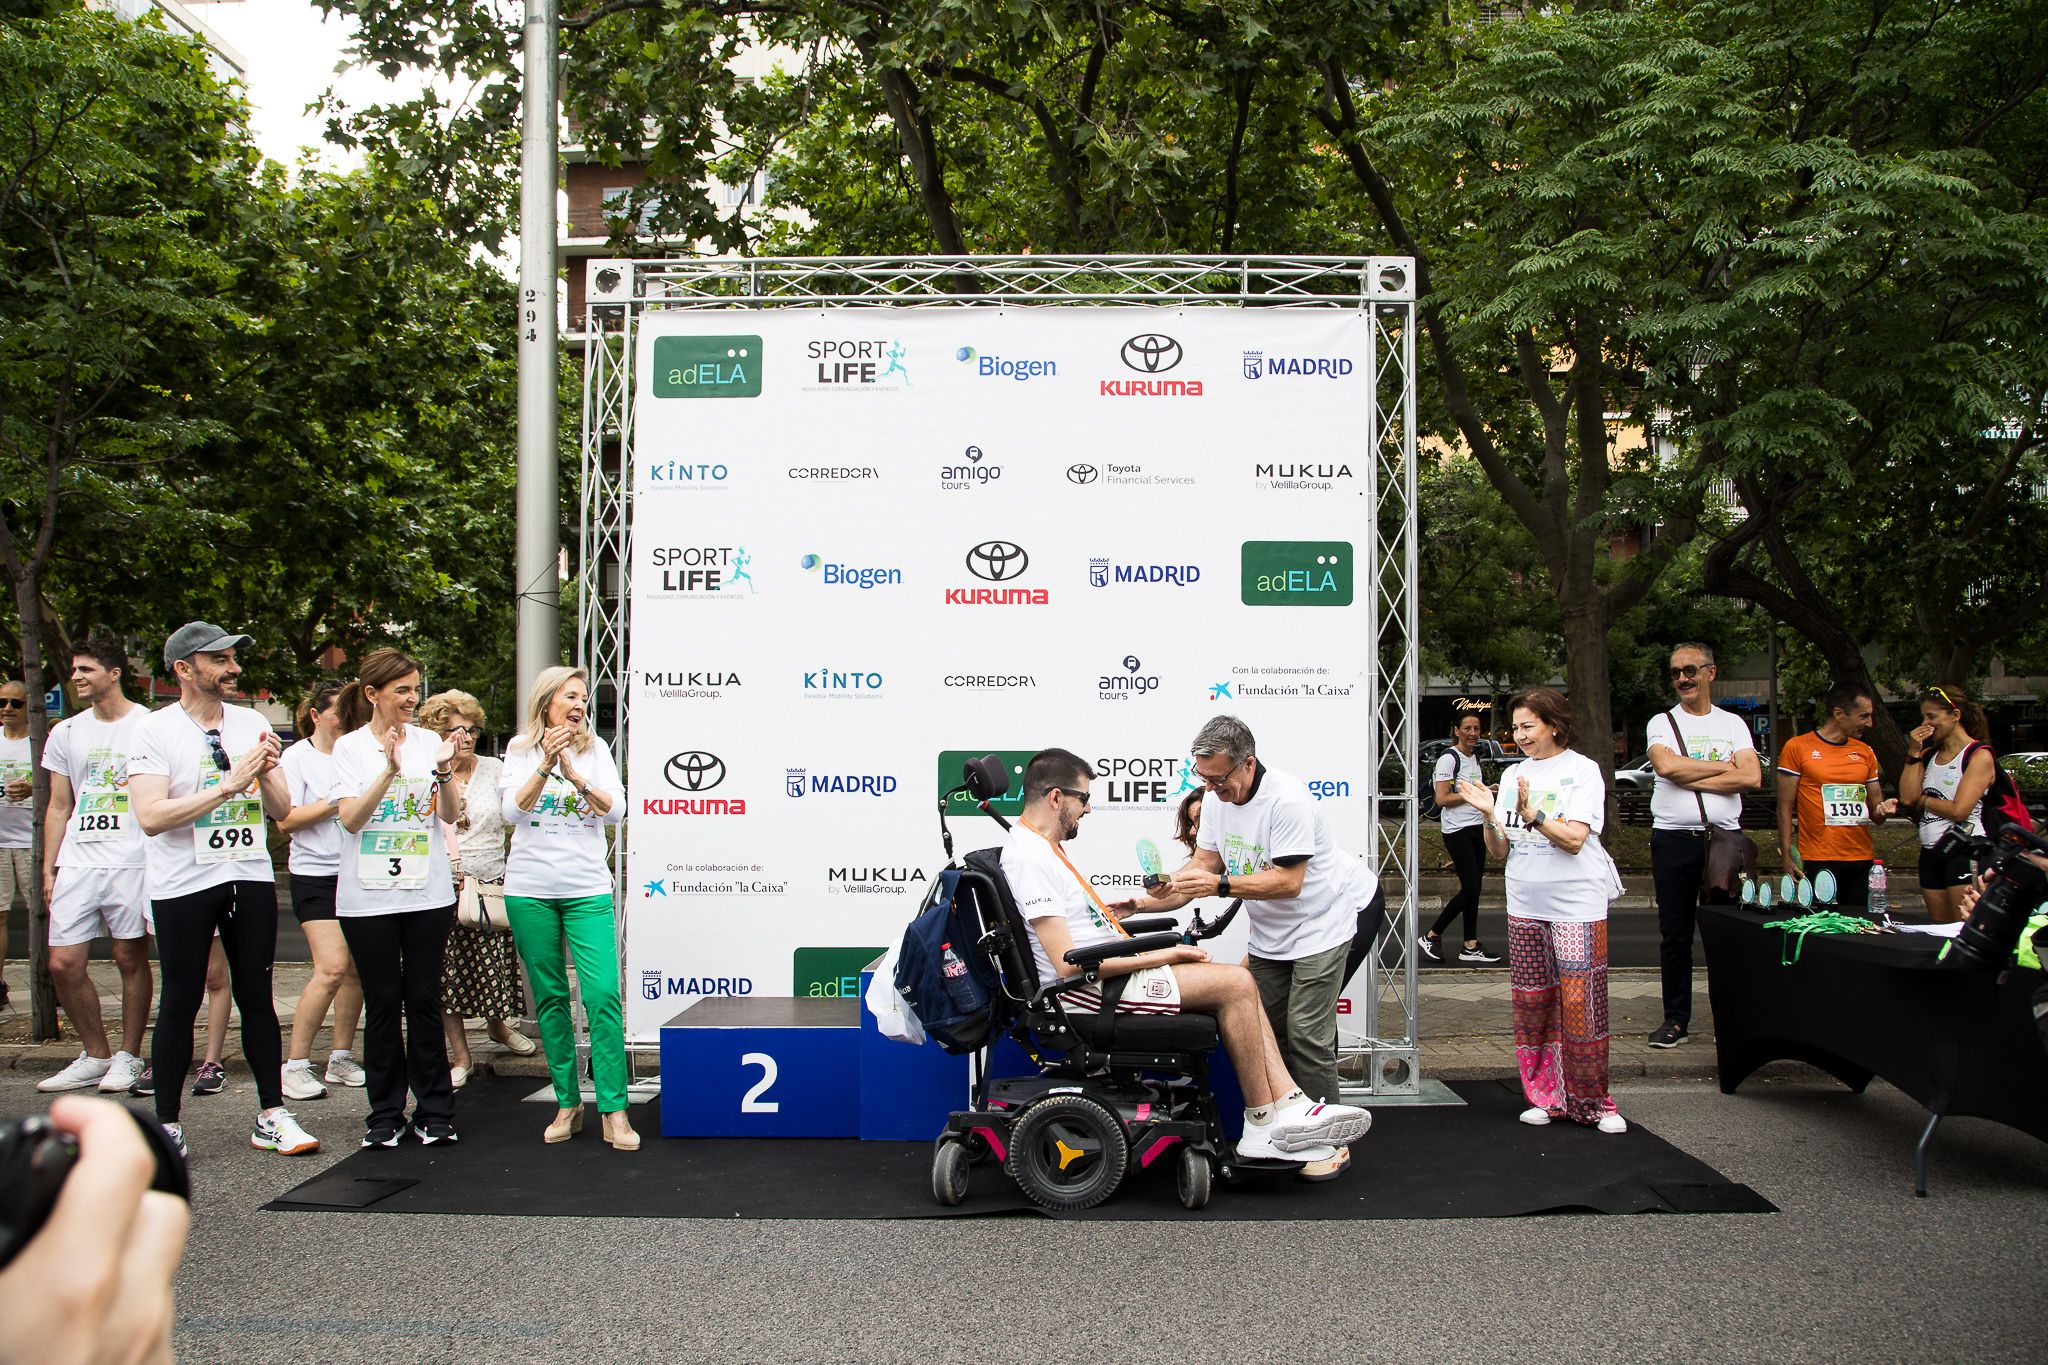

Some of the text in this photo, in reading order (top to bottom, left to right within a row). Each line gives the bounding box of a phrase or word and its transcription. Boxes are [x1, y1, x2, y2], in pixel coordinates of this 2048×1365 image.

[808, 341, 888, 359] SPORT
[668, 363, 747, 385] adELA
[819, 363, 876, 383] LIFE
[977, 356, 1056, 381] Biogen
[1269, 358, 1352, 379] MADRID
[941, 463, 1000, 486] amigo
[1107, 464, 1140, 474] Toyota
[1256, 464, 1352, 477] MUKUA
[942, 481, 970, 489] tours
[1107, 475, 1195, 485] Financial Services
[1256, 481, 1267, 490] by
[653, 548, 733, 566] SPORT
[663, 570, 720, 591] LIFE
[824, 564, 901, 589] Biogen
[1115, 565, 1200, 586] MADRID
[1257, 570, 1338, 592] adELA
[1232, 666, 1249, 674] Con
[1251, 666, 1259, 674] la
[1261, 666, 1315, 674] colaboración
[645, 673, 741, 686] MUKUA
[1099, 676, 1160, 696] amigo
[645, 690, 656, 699] by
[1100, 691, 1128, 700] tours
[1238, 684, 1299, 696] Fundación
[1318, 684, 1355, 696] Caixa"
[1757, 717, 1769, 732] P
[1097, 758, 1178, 777] SPORT
[812, 776, 896, 797] MADRID
[1108, 781, 1167, 803] LIFE
[1308, 780, 1350, 800] gen
[1831, 803, 1863, 817] 1319
[79, 815, 120, 831] 1281
[209, 827, 254, 849] 698
[388, 857, 402, 876] 3
[695, 863, 749, 872] colaboración
[829, 868, 926, 881] MUKUA
[672, 881, 733, 893] Fundación
[752, 881, 788, 893] Caixa"
[828, 885, 840, 894] by
[667, 977, 753, 997] MADRID
[741, 1052, 779, 1113] 2
